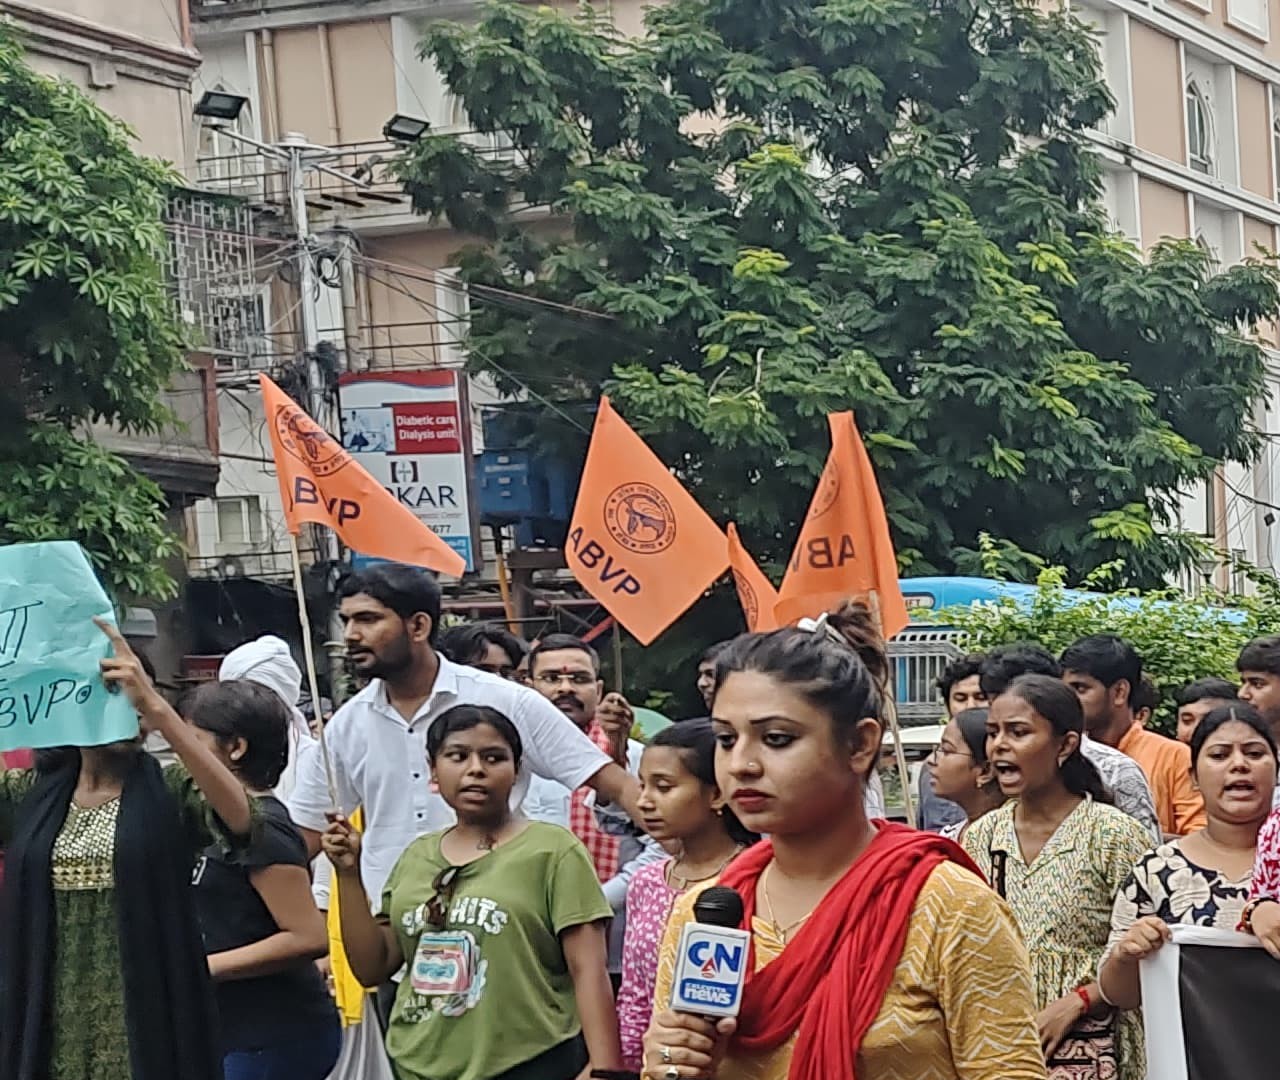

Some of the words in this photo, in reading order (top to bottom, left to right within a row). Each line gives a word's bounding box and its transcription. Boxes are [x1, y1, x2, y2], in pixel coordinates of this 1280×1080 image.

[396, 415, 435, 426] Diabetic
[399, 429, 436, 442] Dialysis
[288, 476, 361, 527] BVP
[385, 485, 458, 508] KAR
[570, 526, 641, 597] ABVP
[450, 896, 508, 935] HITS
[684, 988, 731, 1005] news
